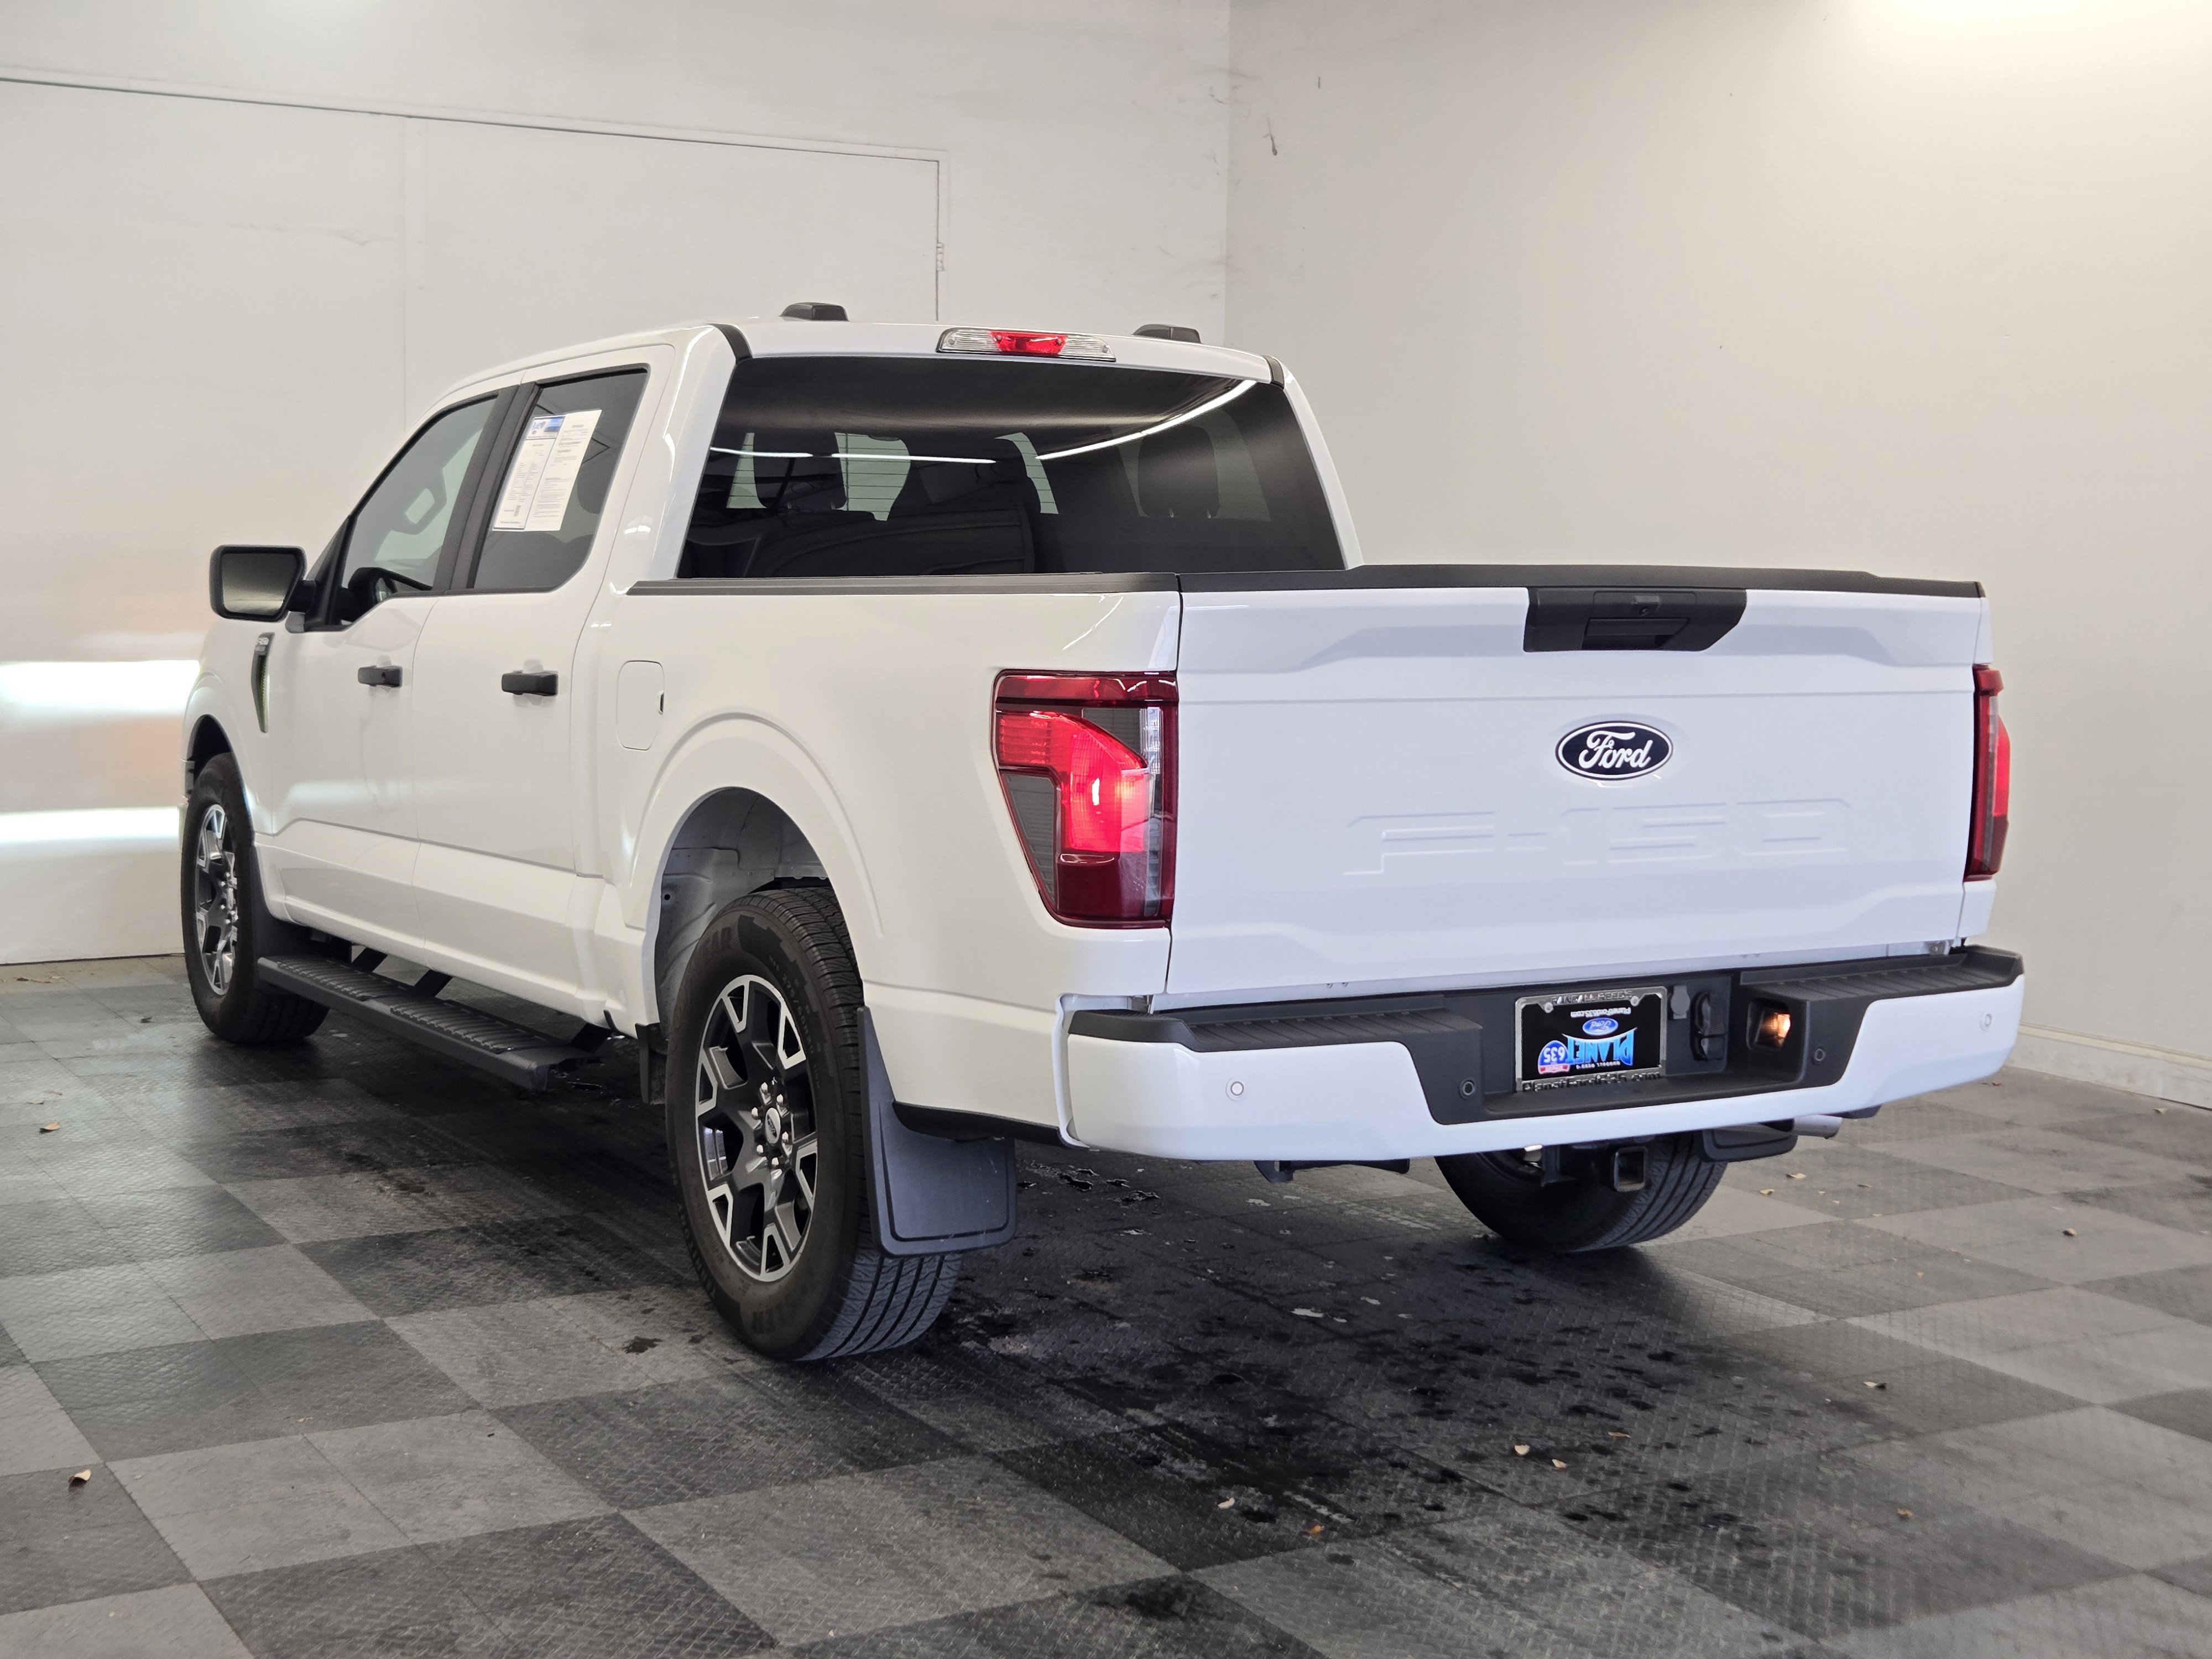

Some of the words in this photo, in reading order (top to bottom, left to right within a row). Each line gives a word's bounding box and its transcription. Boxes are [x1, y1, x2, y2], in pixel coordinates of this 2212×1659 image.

[1579, 731, 1653, 768] Ford
[1342, 799, 1851, 874] F-150
[1590, 1020, 1611, 1032] Ford
[1543, 1046, 1565, 1062] 635
[1567, 1030, 1635, 1066] PLANET
